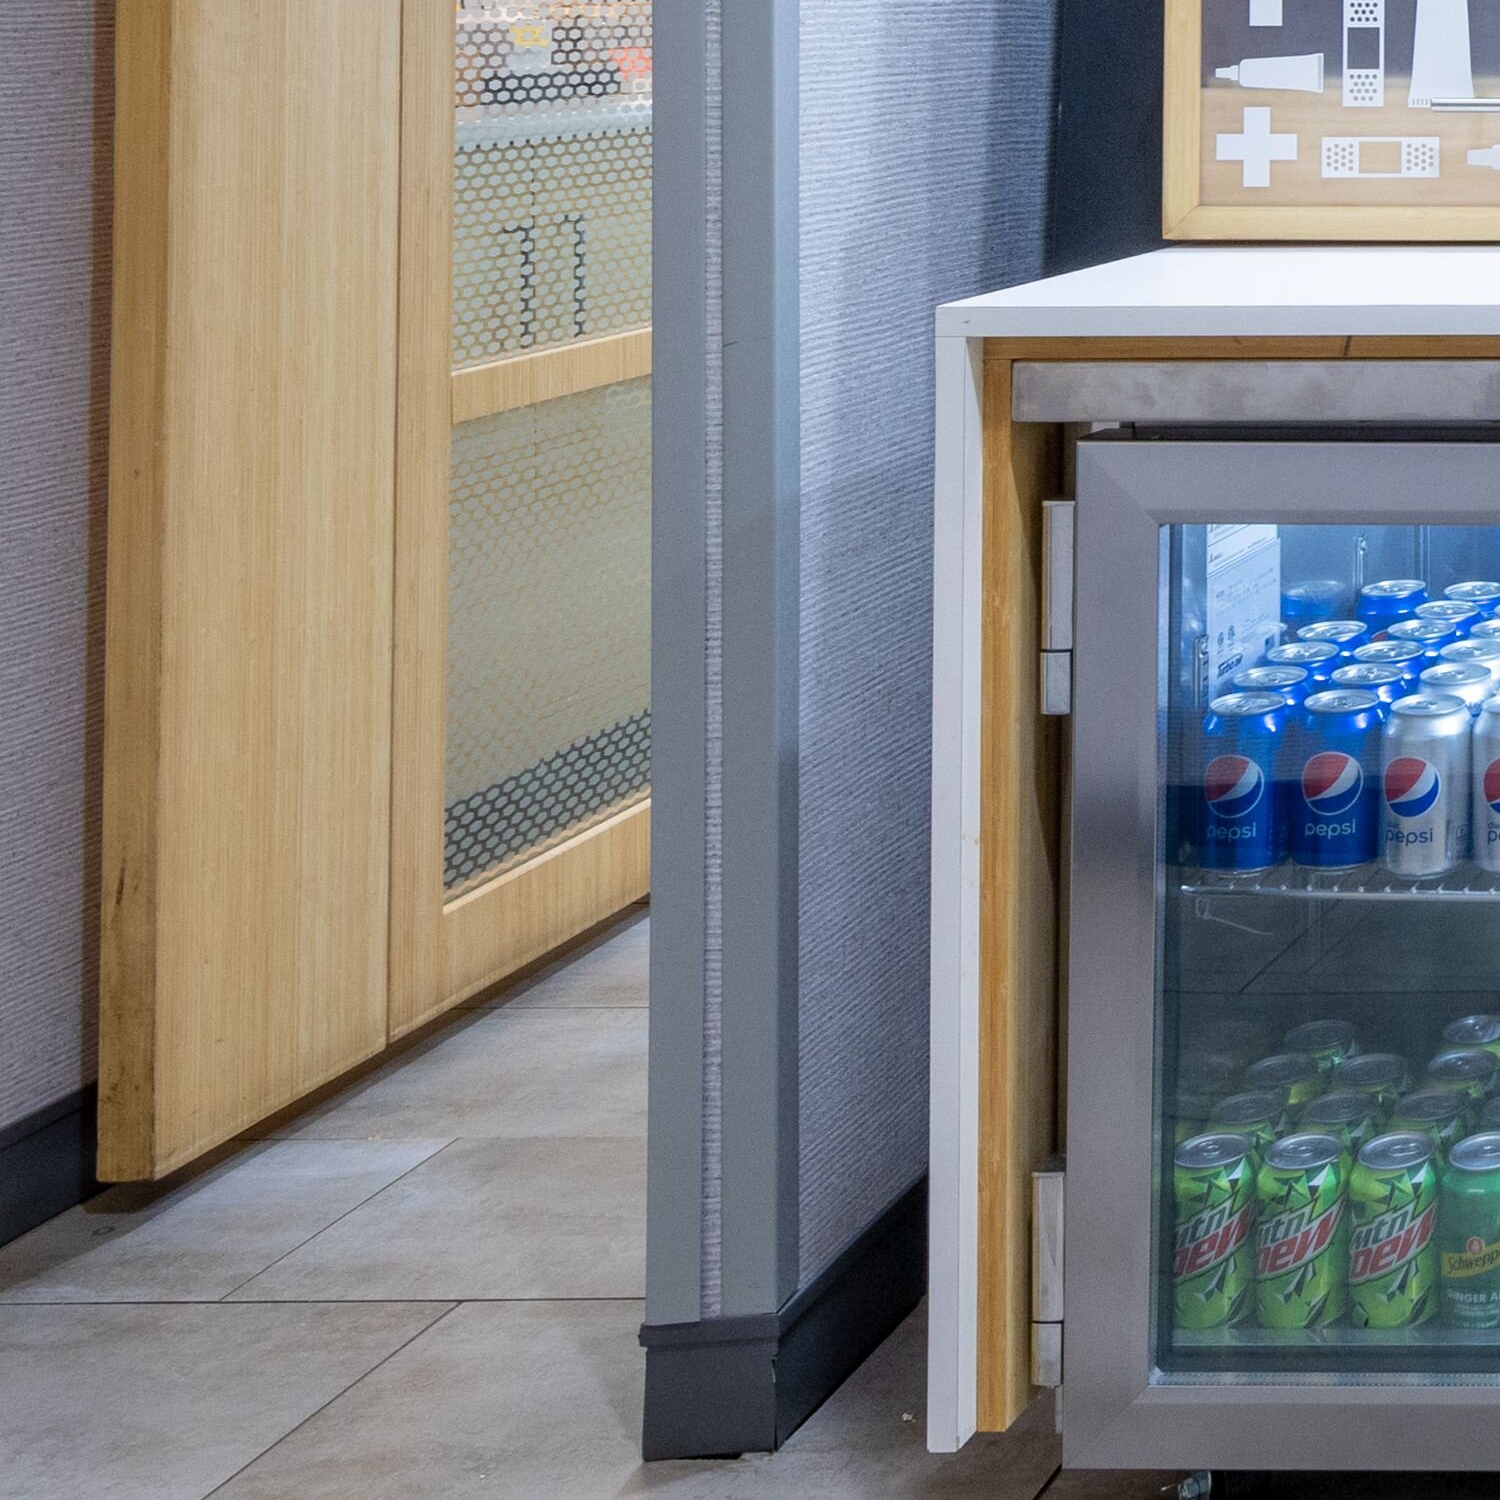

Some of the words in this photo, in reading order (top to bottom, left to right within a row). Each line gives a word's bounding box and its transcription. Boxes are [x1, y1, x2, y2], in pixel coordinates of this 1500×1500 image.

[1206, 822, 1256, 841] pepsi
[1304, 820, 1356, 840] pepsi
[1386, 828, 1433, 846] pepsi
[1448, 1289, 1487, 1302] GINGER
